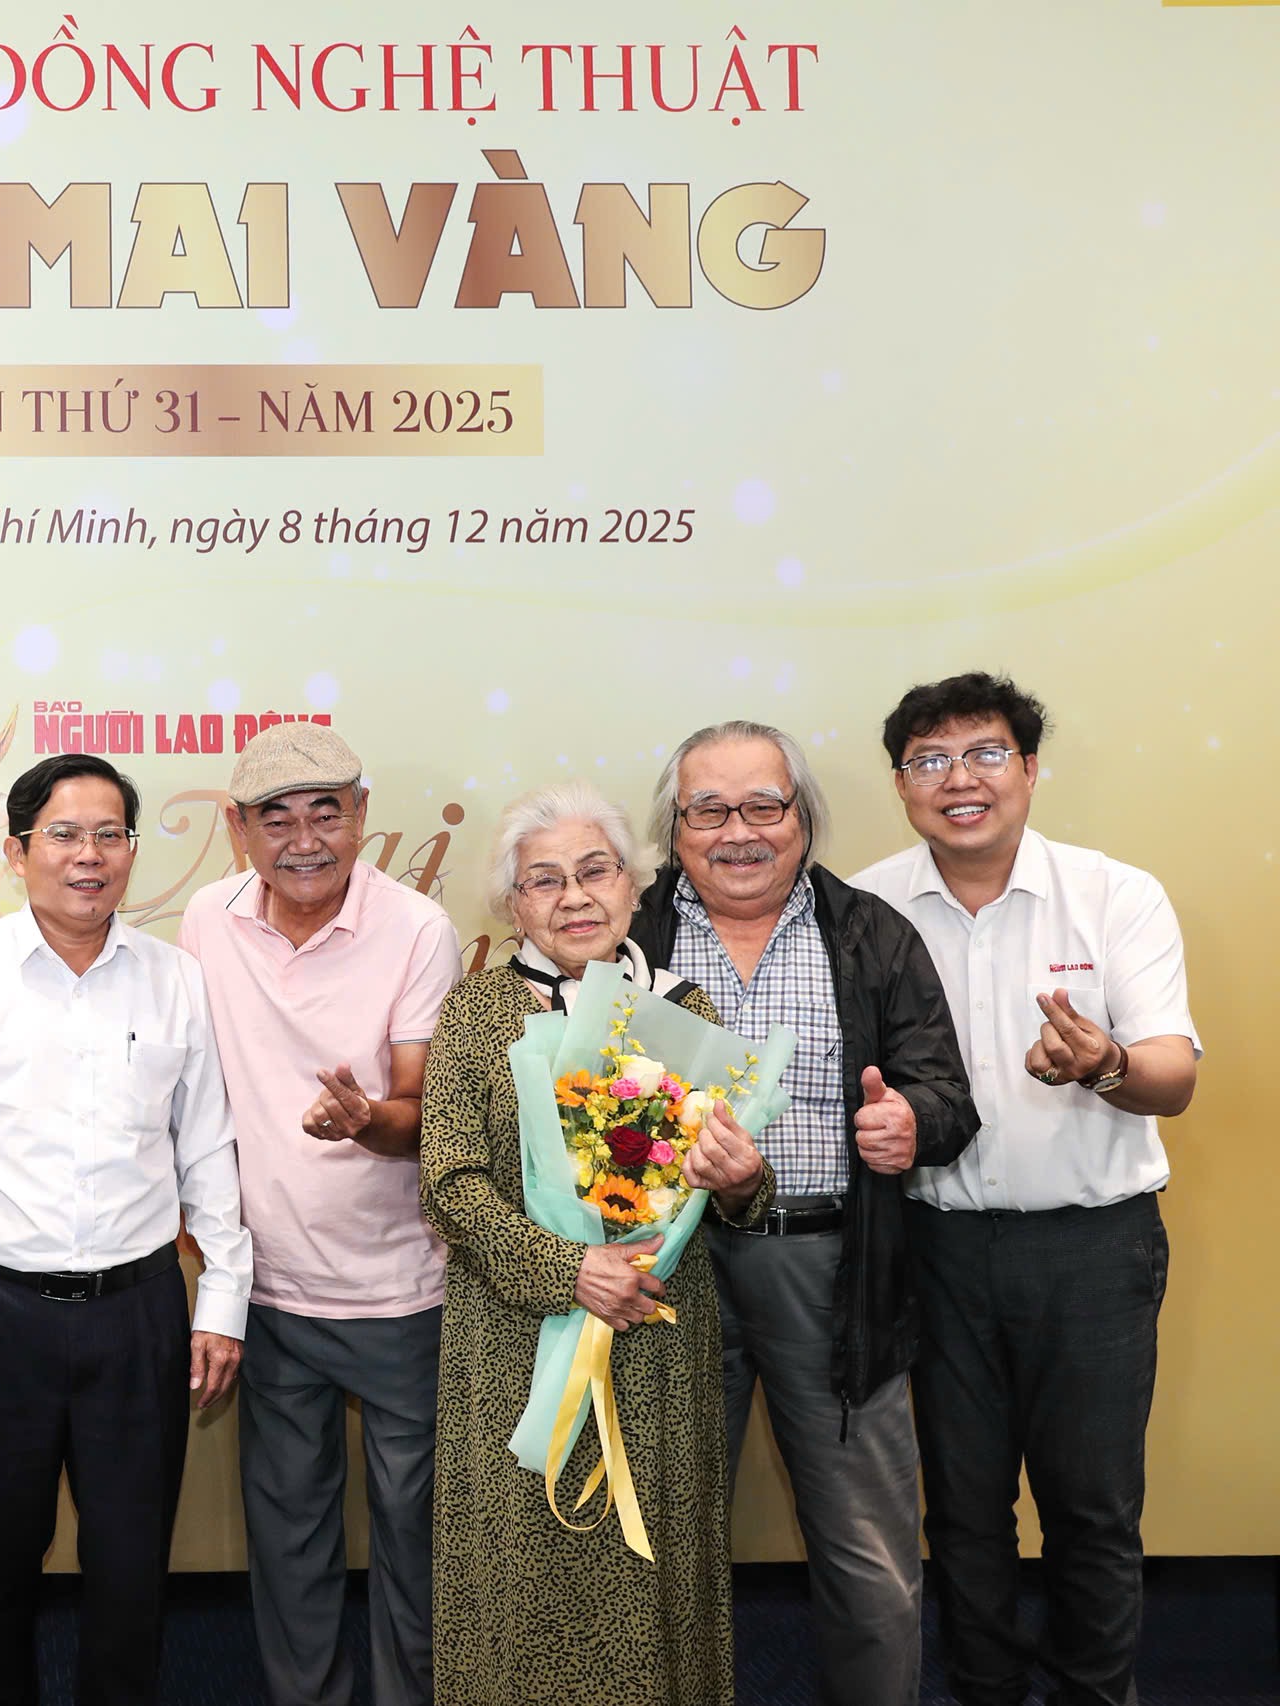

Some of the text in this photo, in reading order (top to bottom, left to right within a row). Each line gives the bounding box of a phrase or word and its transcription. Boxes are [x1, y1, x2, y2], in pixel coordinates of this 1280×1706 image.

[251, 24, 497, 126] NGHỆ
[521, 24, 819, 126] THUẬT
[334, 149, 826, 311] VÀNG
[22, 378, 140, 433] THỨ
[155, 390, 202, 433] 31
[257, 383, 375, 433] NĂM
[392, 389, 514, 434] 2025
[46, 508, 157, 550] Minh,
[170, 508, 270, 554] ngày
[278, 509, 302, 544] 8
[313, 507, 431, 554] tháng
[448, 509, 489, 543] 12
[499, 508, 588, 544] năm
[599, 509, 696, 543] 2025
[155, 714, 223, 754] LAO
